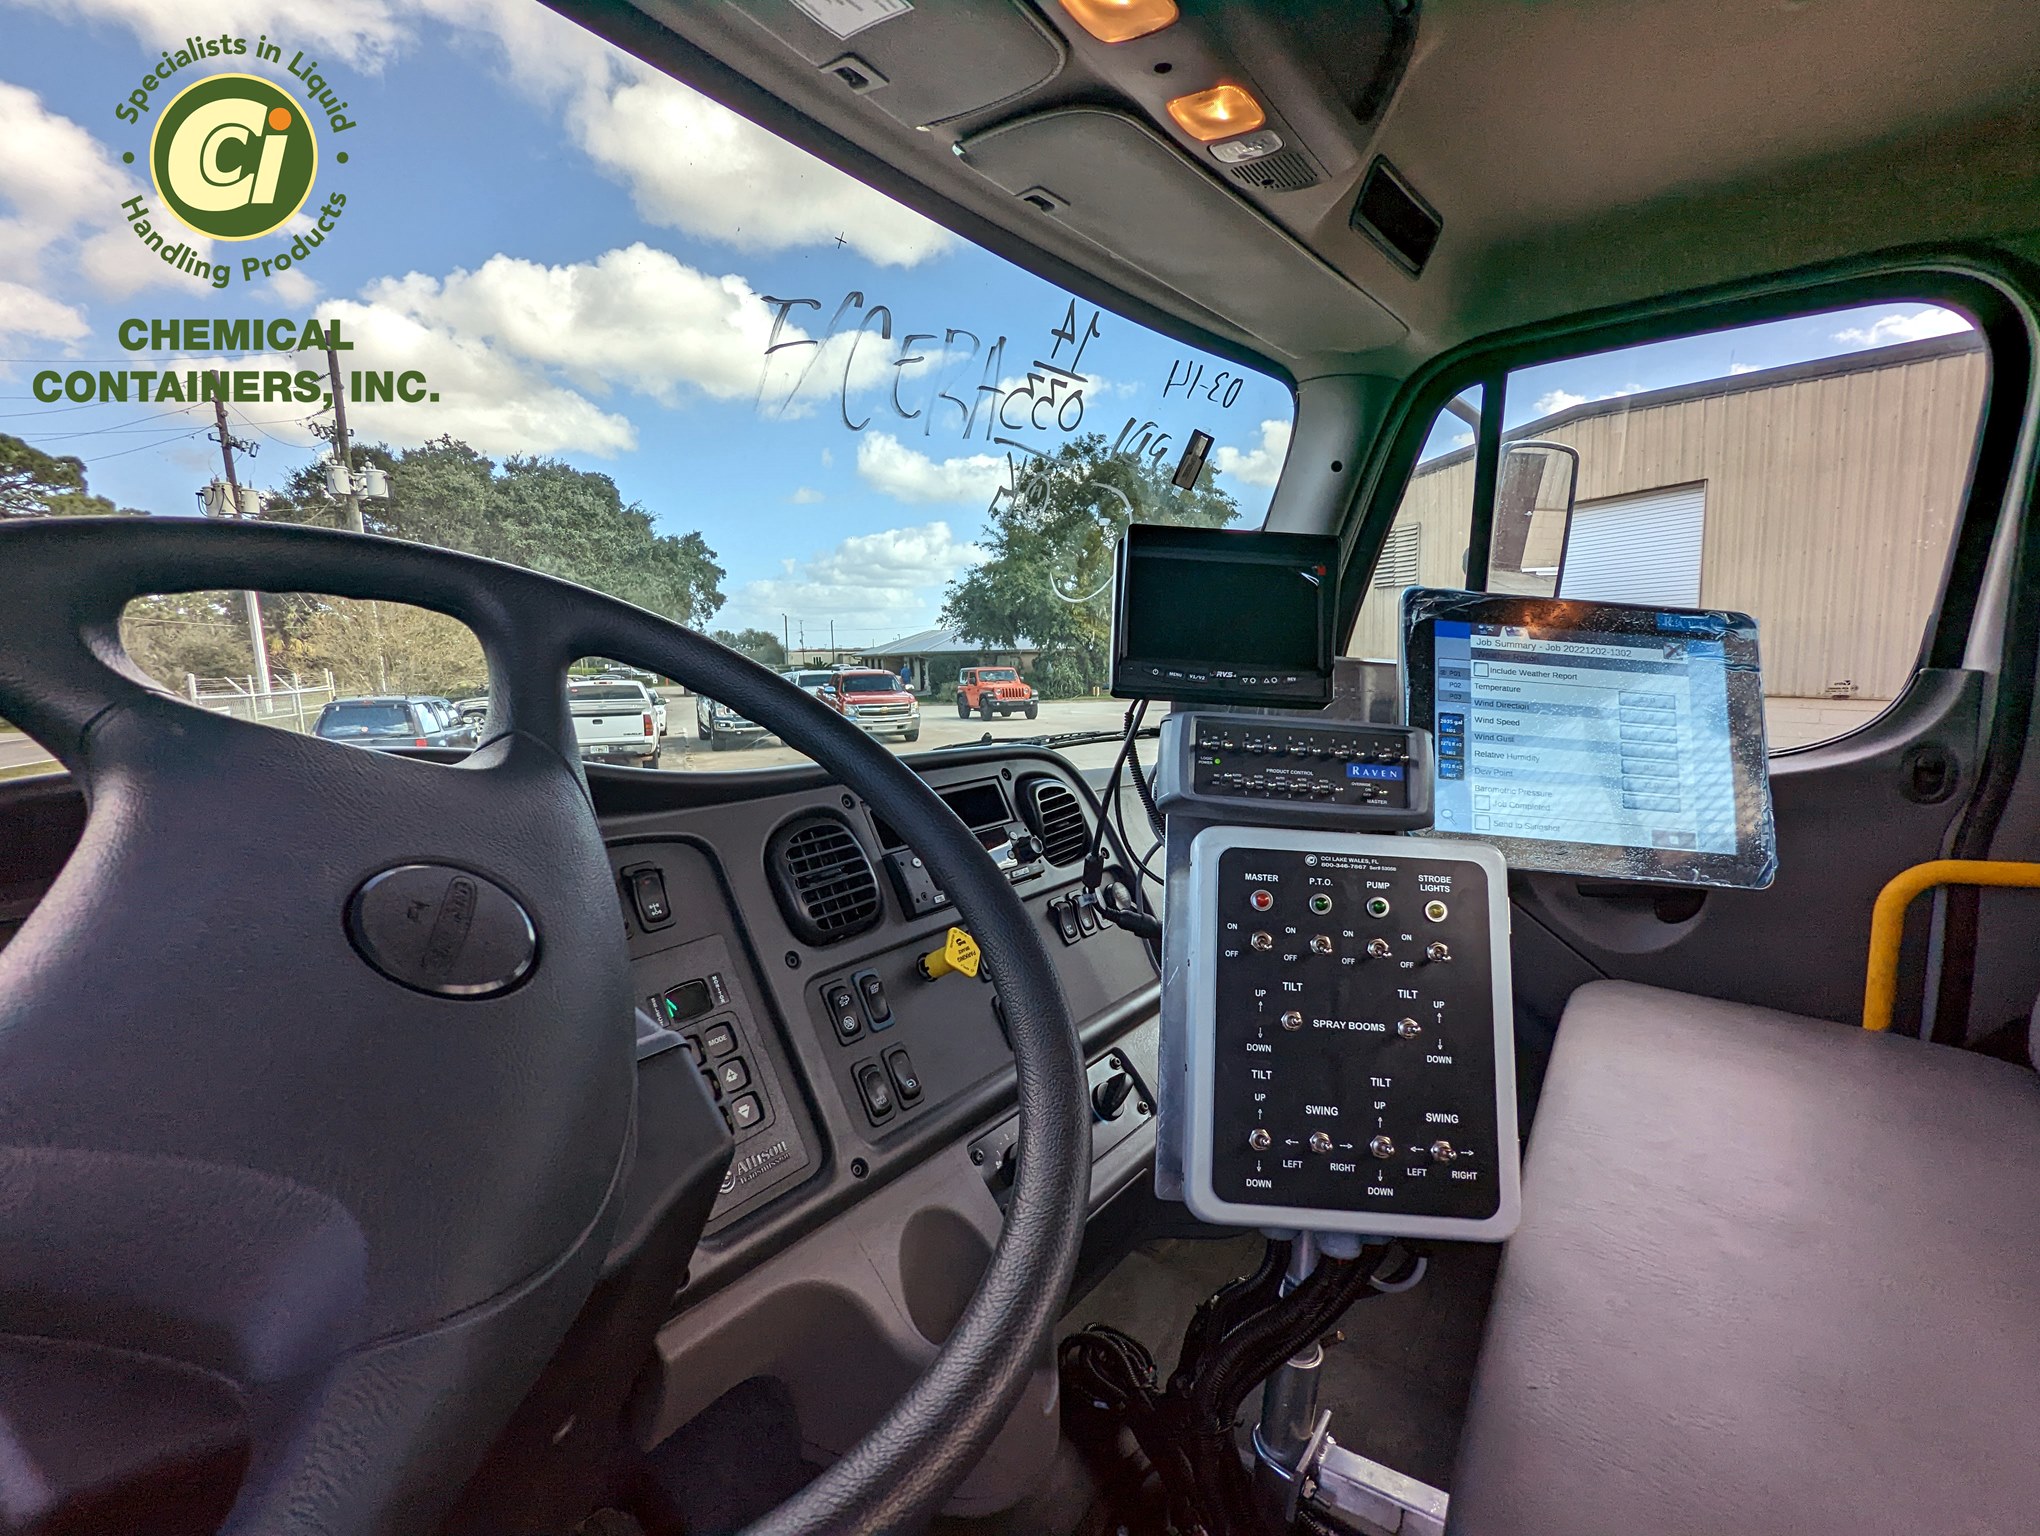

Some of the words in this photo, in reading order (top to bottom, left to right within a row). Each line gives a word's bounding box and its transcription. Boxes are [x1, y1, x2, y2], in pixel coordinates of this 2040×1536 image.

[1476, 638, 1492, 646] Job
[1495, 640, 1537, 652] Summary
[1545, 643, 1561, 652] Job
[1564, 645, 1632, 658] 20221202-1302
[1490, 666, 1517, 676] Include
[1518, 669, 1551, 679] Weather
[1552, 671, 1578, 680] Report
[1474, 682, 1521, 693] Temperature
[1474, 700, 1494, 708] Wind
[1496, 701, 1530, 710] Direction
[1474, 716, 1494, 724] Wind
[1496, 718, 1520, 726] Speed
[1474, 734, 1494, 742] Wind
[1474, 750, 1504, 759] Relative
[1506, 752, 1540, 763] Humidity
[1494, 769, 1513, 777] Point
[1518, 788, 1552, 798] Pressure
[1493, 820, 1514, 828] Send
[1244, 873, 1279, 882] MASTER
[1308, 878, 1334, 886] P.T.O.
[1418, 874, 1452, 884] STROBE
[1366, 881, 1390, 890] PUMP
[1420, 884, 1450, 893] LIGHTS
[1284, 954, 1298, 962] OFF
[1400, 961, 1414, 969] OFF
[1282, 982, 1304, 992] TILT
[1254, 989, 1267, 997] UP
[1397, 988, 1418, 999] TILT
[1433, 1000, 1446, 1009] UP
[1312, 1019, 1347, 1030] SPRAY
[1348, 1022, 1386, 1032] BOOMS
[708, 1034, 728, 1047] MODE
[1246, 1043, 1272, 1052] DOWN
[1426, 1055, 1452, 1064] DOWN
[1251, 1070, 1272, 1080] TILT
[1370, 1077, 1392, 1088] TILT
[1254, 1093, 1266, 1101] UP
[1305, 1104, 1339, 1116] SWING
[1374, 1101, 1386, 1110] UP
[1426, 1112, 1460, 1124] SWING
[737, 1141, 788, 1176] Allison
[1282, 1160, 1303, 1169] LEFT
[1330, 1162, 1356, 1173] RIGHT
[1406, 1168, 1427, 1177] LEFT
[1452, 1170, 1478, 1181] RIGHT
[1246, 1178, 1272, 1188] DOWN
[1367, 1186, 1394, 1196] DOWN
